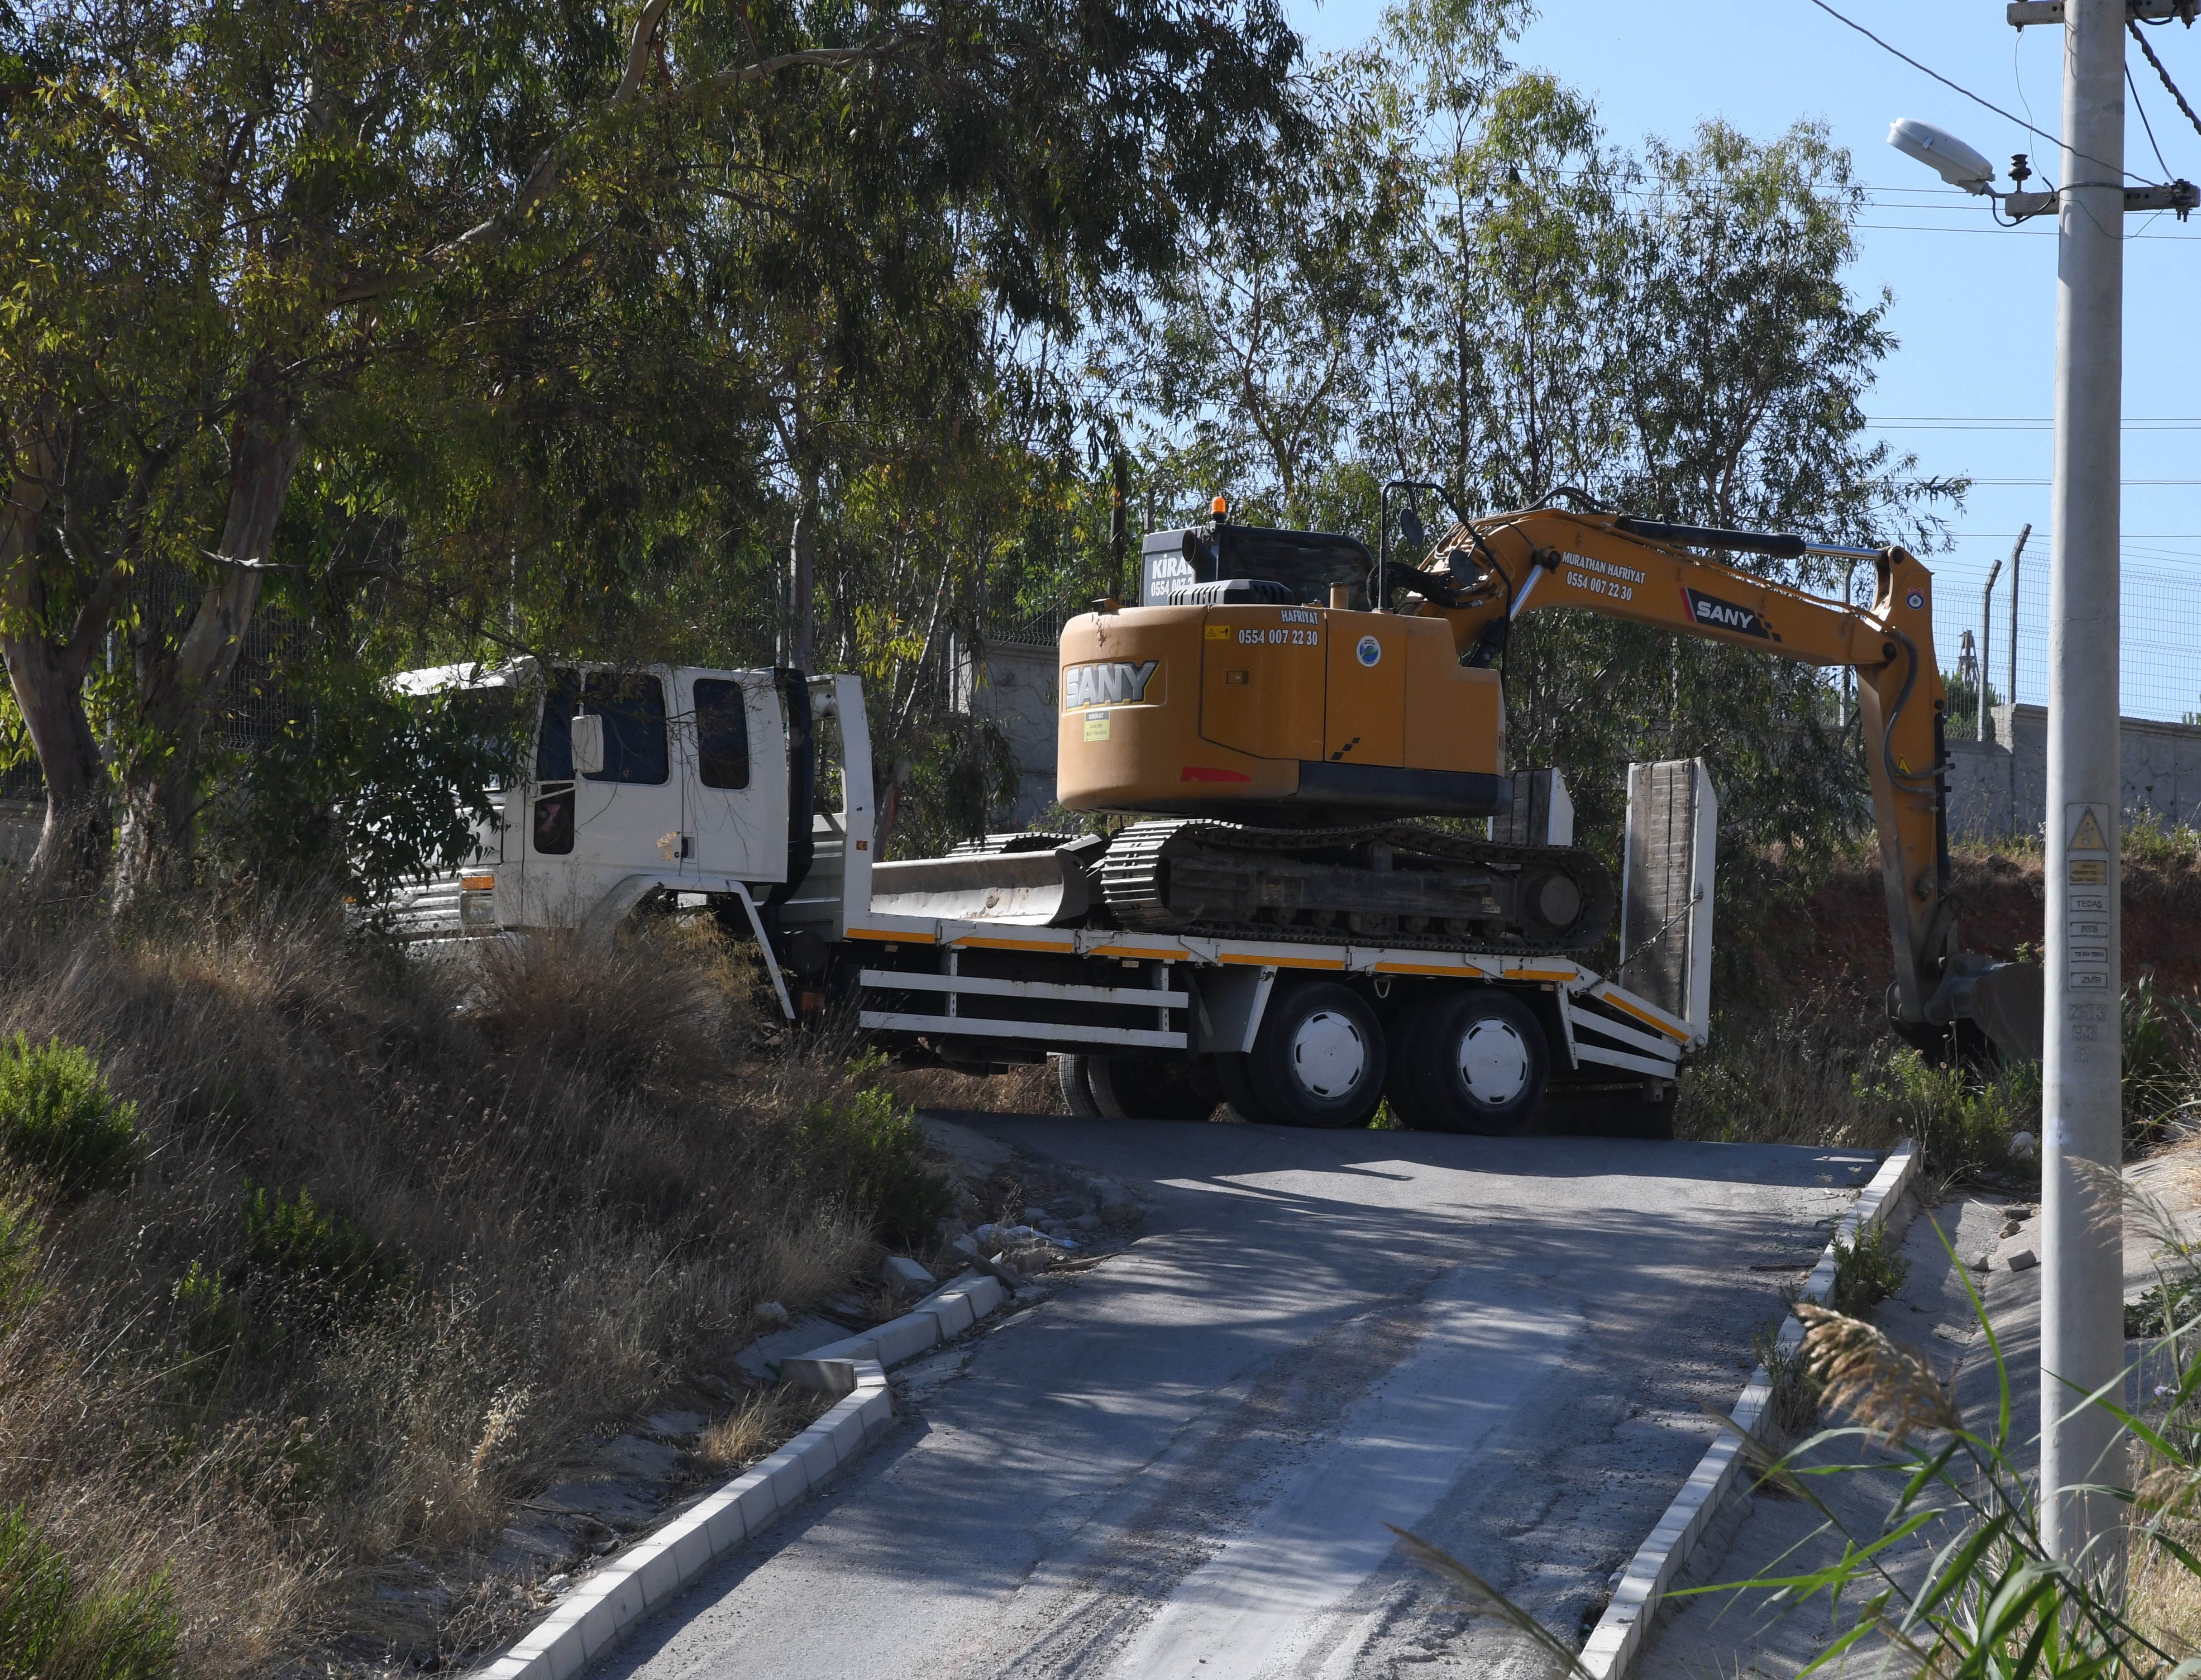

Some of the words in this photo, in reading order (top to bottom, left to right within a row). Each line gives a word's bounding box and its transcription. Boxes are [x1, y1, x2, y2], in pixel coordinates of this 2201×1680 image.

[1562, 551, 1606, 573] MURATHAN
[1607, 563, 1646, 584] HAFRİYAT
[1151, 580, 1169, 597] 0554
[1567, 571, 1588, 589] 0554
[1590, 578, 1606, 593] 007
[1608, 582, 1619, 597] 22
[1621, 586, 1632, 601] 30
[1281, 609, 1318, 624] HAFRİYAT
[1697, 601, 1753, 628] SANY
[1238, 629, 1265, 644] 0554
[1269, 629, 1289, 644] 007
[1292, 630, 1303, 644] 22
[1306, 630, 1318, 645] 30
[1066, 661, 1158, 708] SANY
[2077, 901, 2102, 909] TEDAŞ
